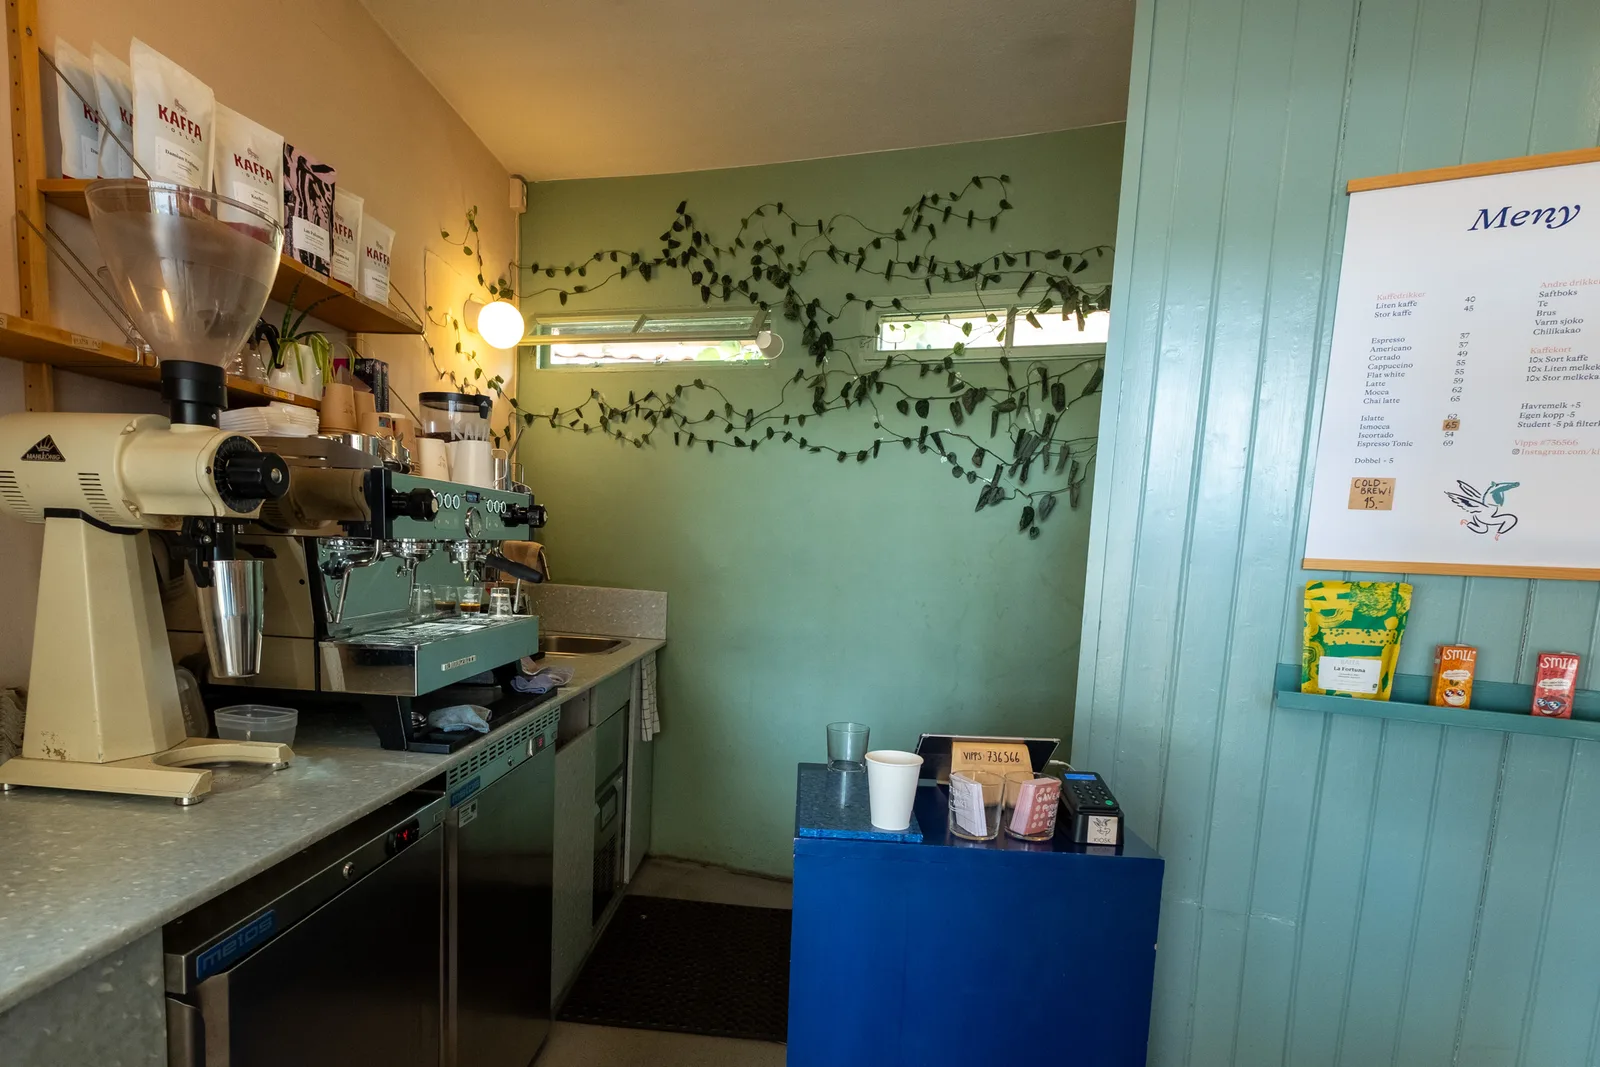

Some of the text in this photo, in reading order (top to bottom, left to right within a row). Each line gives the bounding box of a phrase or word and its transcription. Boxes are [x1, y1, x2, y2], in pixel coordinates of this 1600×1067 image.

[158, 104, 202, 142] KAFFA
[234, 153, 274, 184] KAFFA
[1467, 205, 1581, 231] Meny
[1377, 292, 1426, 301] Kaffedrikker
[1539, 289, 1577, 298] Saftboks
[1398, 300, 1417, 308] kaffe
[1393, 309, 1412, 317] kaffe
[1560, 317, 1584, 326] sjoko
[1533, 327, 1581, 336] Chilikakao
[1371, 337, 1405, 345] Espresso
[1370, 345, 1412, 353] Americano
[1530, 346, 1572, 354] Kaffekort
[1566, 354, 1589, 362] kaffe
[1367, 362, 1413, 371] Cappuccino
[1367, 371, 1382, 379] Flat
[1384, 370, 1405, 378] white
[1542, 374, 1561, 382] Stor
[1519, 412, 1541, 420] Egen
[1543, 411, 1564, 420] kopp
[1445, 421, 1458, 429] 65
[1553, 420, 1561, 428] -5
[1563, 420, 1574, 429] på
[1357, 441, 1390, 449] Espresso
[1354, 479, 1388, 488] COLD-
[1360, 486, 1391, 496] BREW!
[1444, 649, 1474, 662] SMIL
[1540, 657, 1575, 669] SMIL
[203, 917, 272, 970] metos
